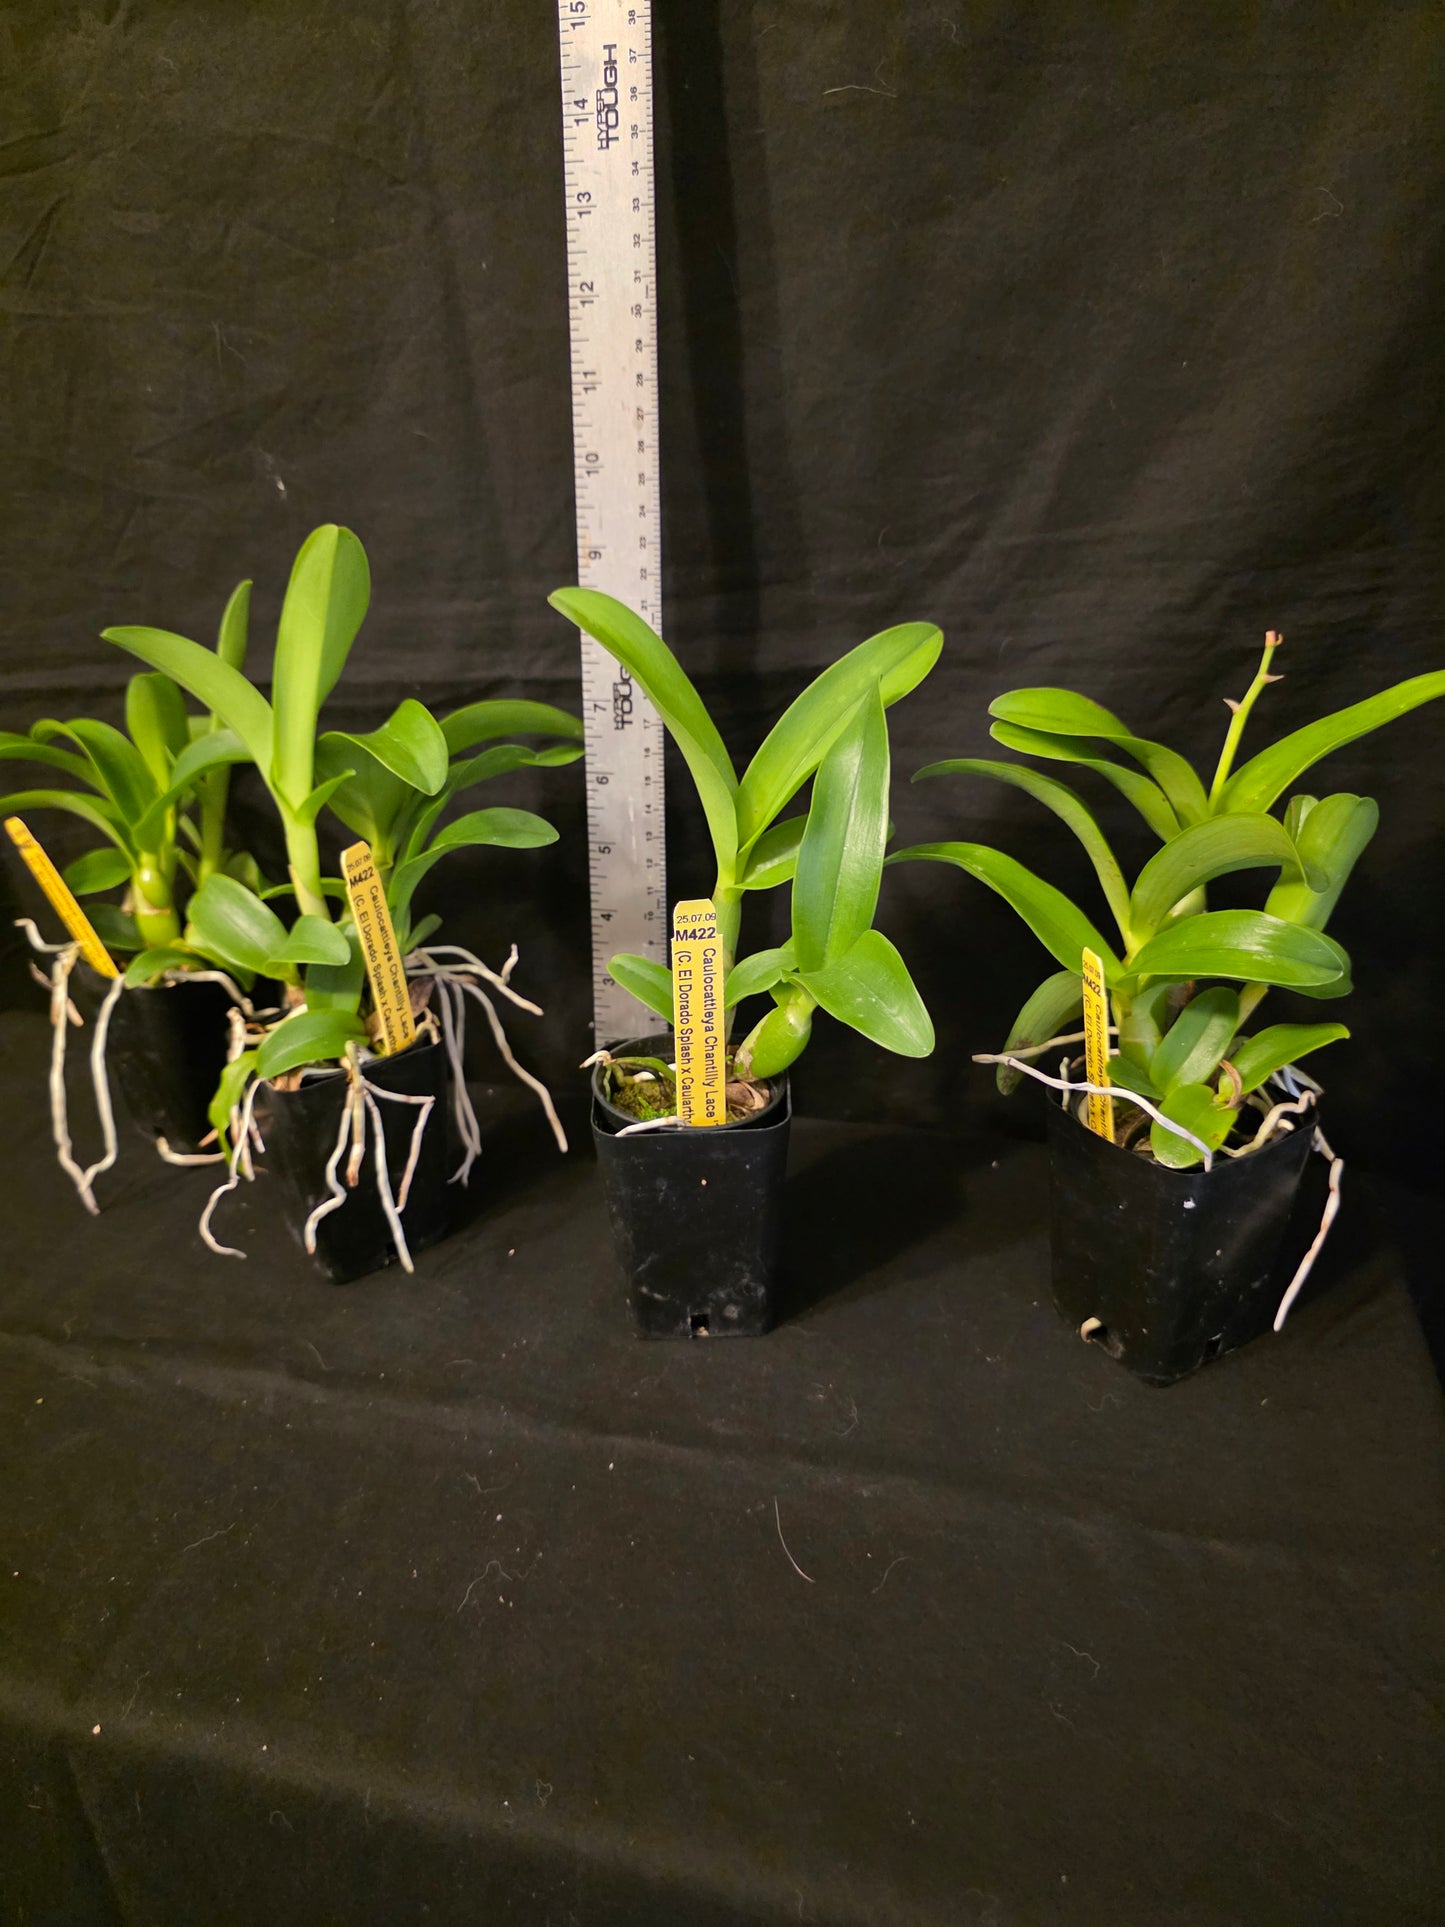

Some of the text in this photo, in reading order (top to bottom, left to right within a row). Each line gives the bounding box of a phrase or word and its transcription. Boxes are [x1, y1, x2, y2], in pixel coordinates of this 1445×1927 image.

[570, 1, 586, 30] 15
[628, 9, 637, 25] 38
[629, 48, 637, 64] 37
[603, 44, 619, 150] TOUGH
[630, 86, 638, 102] 36
[573, 98, 589, 127] 14
[596, 89, 608, 150] HYPER
[631, 124, 639, 140] 35
[632, 161, 640, 177] 34
[577, 192, 592, 219] 13
[633, 197, 641, 213] 33
[633, 233, 641, 248] 32
[634, 269, 642, 282] 31
[580, 281, 594, 308] 12
[635, 303, 643, 318] 30
[636, 339, 643, 353] 29
[583, 371, 597, 394] 11
[636, 373, 644, 387] 28
[637, 408, 644, 421] 27
[585, 453, 599, 477] 10
[639, 505, 646, 518] 24
[589, 551, 602, 560] 9
[640, 568, 647, 580] 22
[641, 600, 648, 611] 21
[619, 664, 632, 730] TOUG
[594, 704, 606, 713] 7
[643, 719, 650, 730] 17
[597, 776, 609, 785] 6
[599, 846, 611, 854] 5
[349, 867, 374, 888] M422
[601, 913, 613, 922] 4
[675, 927, 717, 942] M422
[362, 923, 378, 963] Dorado
[371, 963, 386, 997] Splash
[368, 885, 393, 963] Caulocattleya
[399, 1011, 410, 1040] Lace
[675, 950, 692, 968] (C.
[603, 978, 615, 986] 3
[678, 969, 693, 981] El
[700, 948, 717, 1033] Caulocattleya
[679, 984, 694, 1025] Dorado
[677, 1028, 694, 1065] Splash
[705, 1090, 718, 1118] Lace
